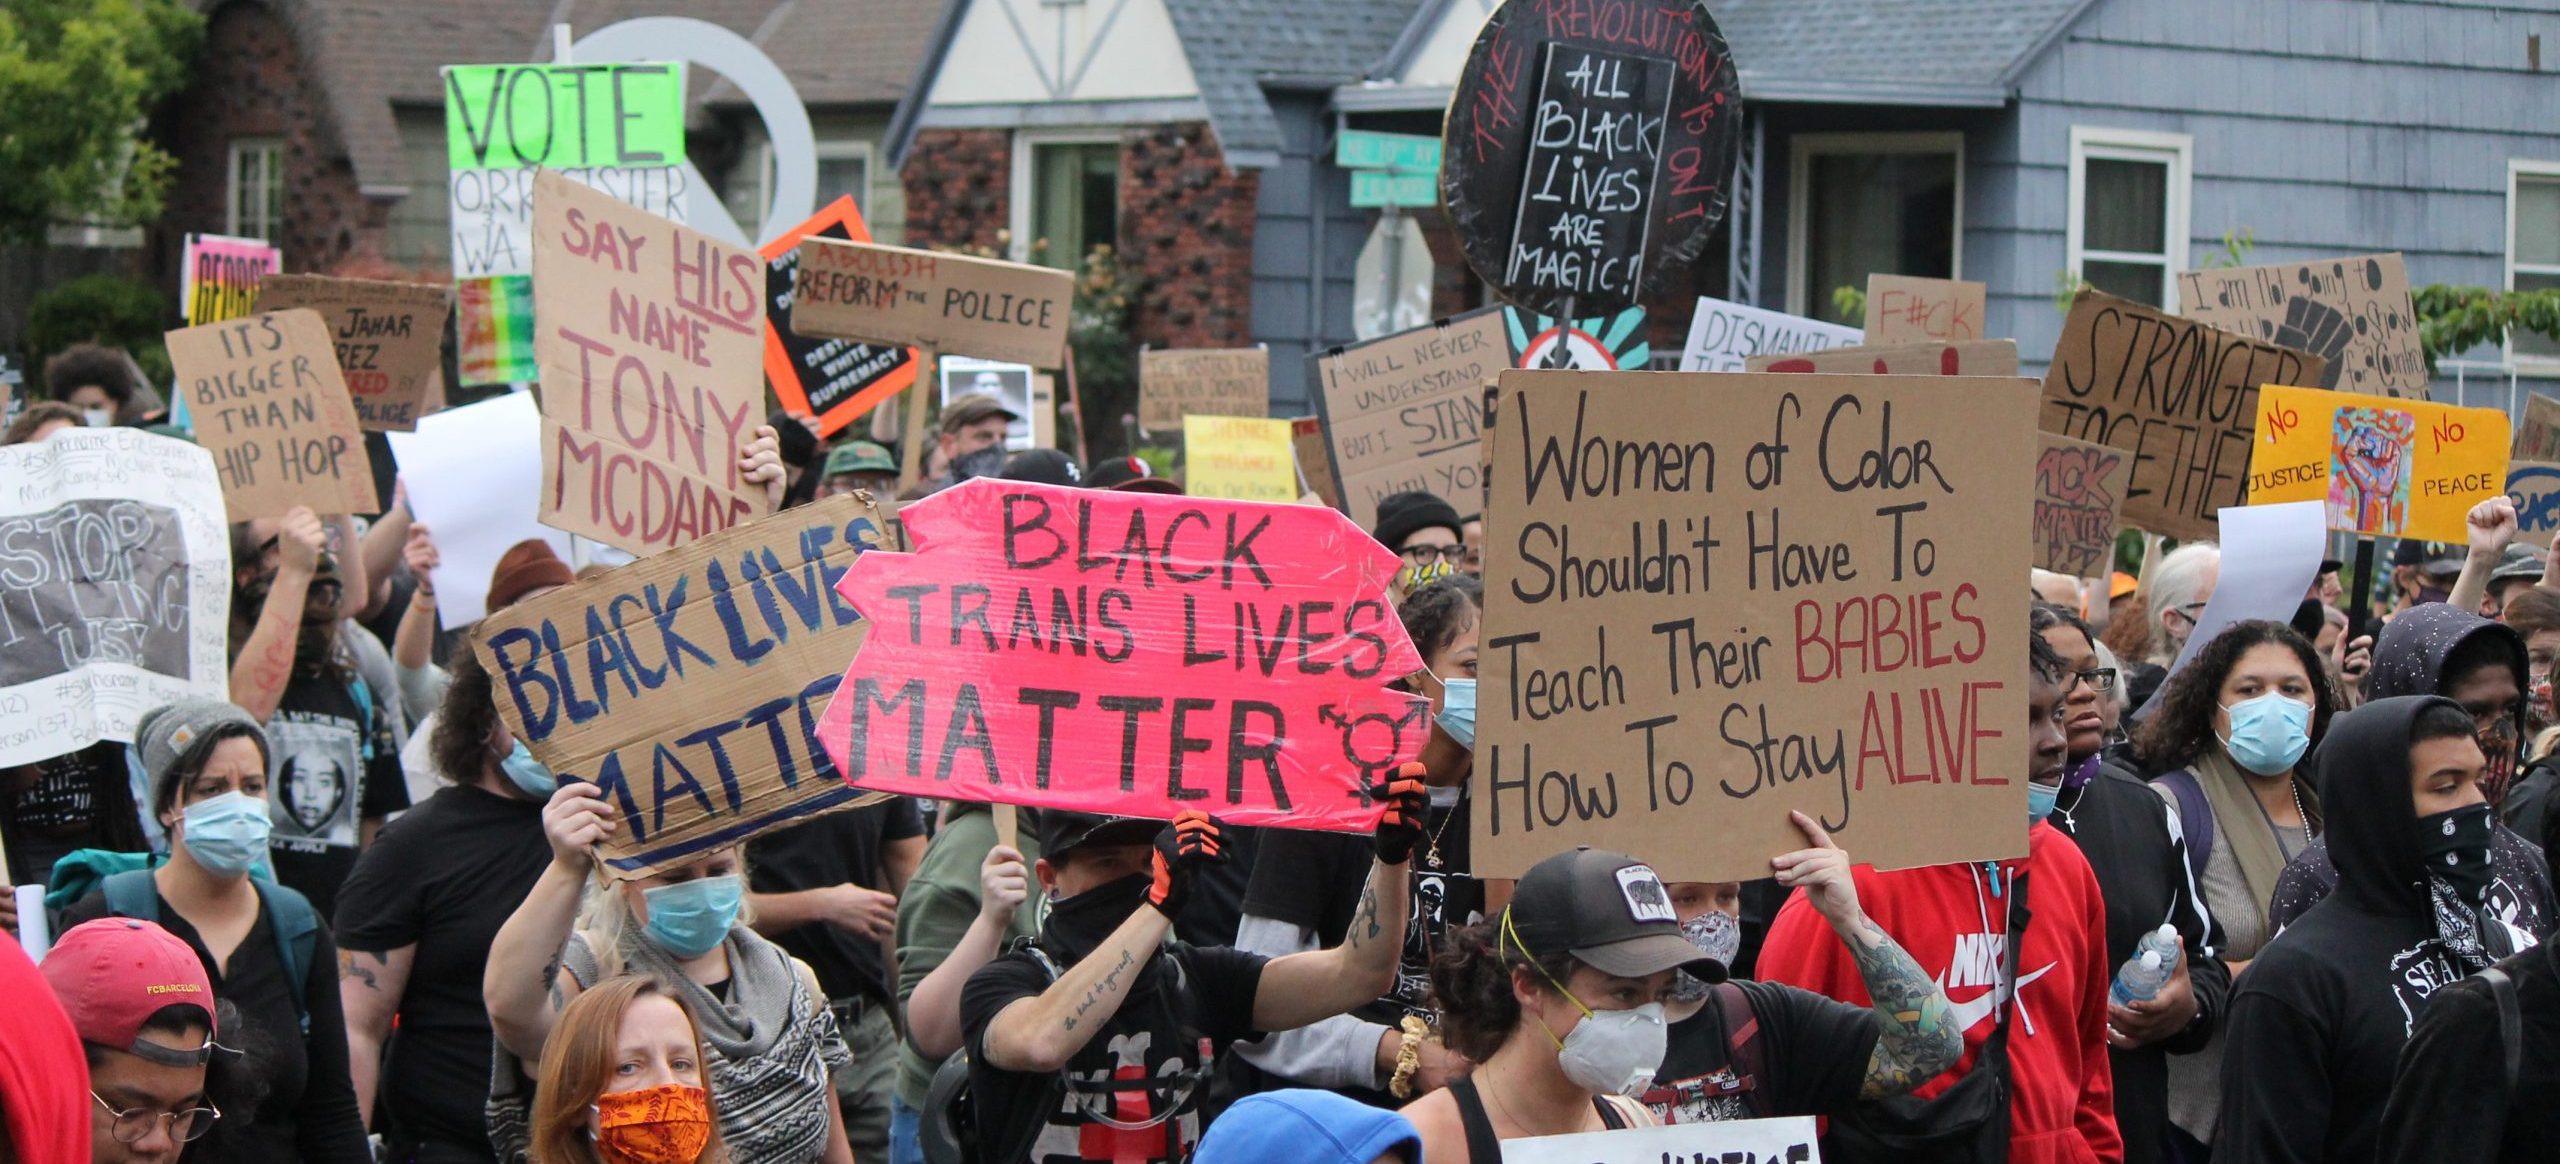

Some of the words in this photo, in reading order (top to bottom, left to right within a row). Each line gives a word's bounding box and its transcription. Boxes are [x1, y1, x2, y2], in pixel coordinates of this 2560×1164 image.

[1566, 54, 1630, 98] ALL
[446, 66, 669, 167] VOTE
[1537, 100, 1662, 160] BLACK
[1549, 211, 1604, 247] ARE
[562, 207, 646, 274] SAY
[674, 229, 758, 326] HIS
[2186, 272, 2212, 312] I
[610, 287, 712, 368] NAME
[800, 267, 899, 310] REFORM
[905, 290, 928, 305] THE
[942, 287, 1053, 330] POLICE
[1881, 290, 1975, 340] F#CK
[219, 316, 282, 359] ITS
[822, 342, 871, 378] WHITE
[1329, 368, 1338, 389] I
[1344, 355, 1404, 383] WILL
[1413, 329, 1491, 366] NEVER
[194, 354, 322, 405] BIGGER
[809, 347, 899, 407] SUPREMACY
[1355, 362, 1482, 411] UNDERSTAND
[215, 393, 315, 435] THAN
[558, 326, 749, 491] TONY
[219, 439, 262, 489] HIP
[278, 434, 347, 485] HOP
[1343, 430, 1372, 460] BUT
[1377, 428, 1392, 452] I
[1516, 389, 1714, 506] Women
[1745, 391, 1801, 491] of
[2250, 461, 2326, 493] JUSTICE
[2423, 472, 2493, 497] PEACE
[0, 502, 154, 590] STOP
[1000, 493, 1274, 591] BLACK
[1511, 515, 1720, 604] Shouldn't
[1746, 507, 1857, 592] Have
[1876, 501, 1936, 582] To
[58, 619, 149, 672] US!
[486, 572, 719, 744] BLACK
[886, 583, 1136, 665] TRANS
[1182, 592, 1389, 681] LIVES
[1488, 625, 1625, 722] Teach
[1651, 617, 1772, 696] Their
[1794, 582, 1986, 684] BABIES
[848, 677, 1293, 814] MATTER
[1489, 742, 1617, 837] How
[1625, 714, 1694, 812] To
[1719, 702, 1850, 834] Stay
[1855, 681, 2010, 791] ALIVE
